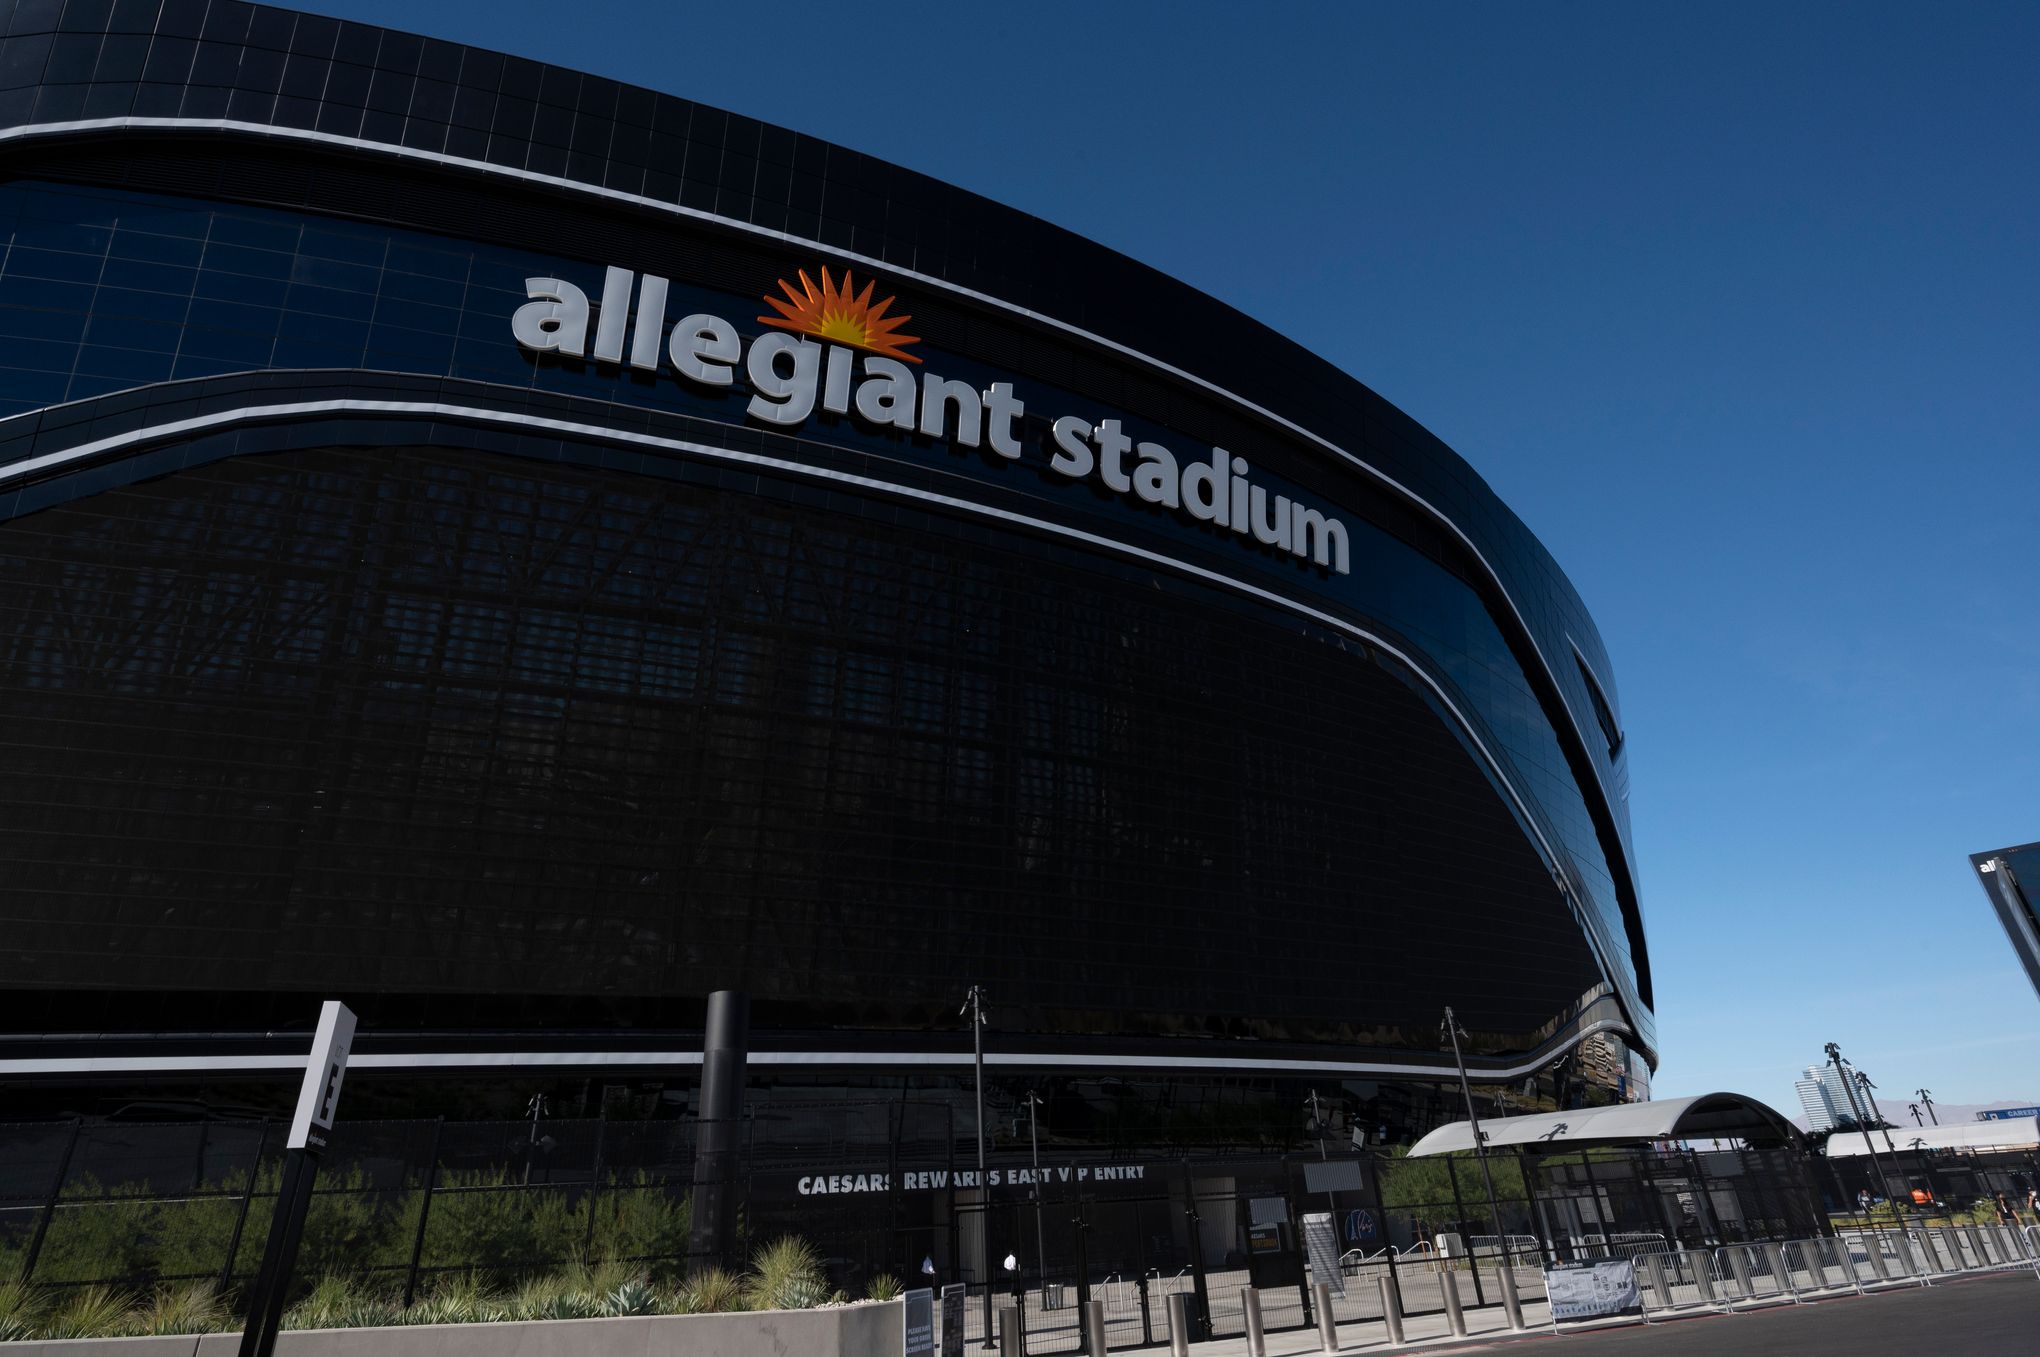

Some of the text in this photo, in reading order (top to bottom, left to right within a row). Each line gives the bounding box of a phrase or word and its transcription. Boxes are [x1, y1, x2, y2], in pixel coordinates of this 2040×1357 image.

[511, 265, 1351, 575] allegiant stadium
[1094, 1165, 1145, 1181] ENTRY
